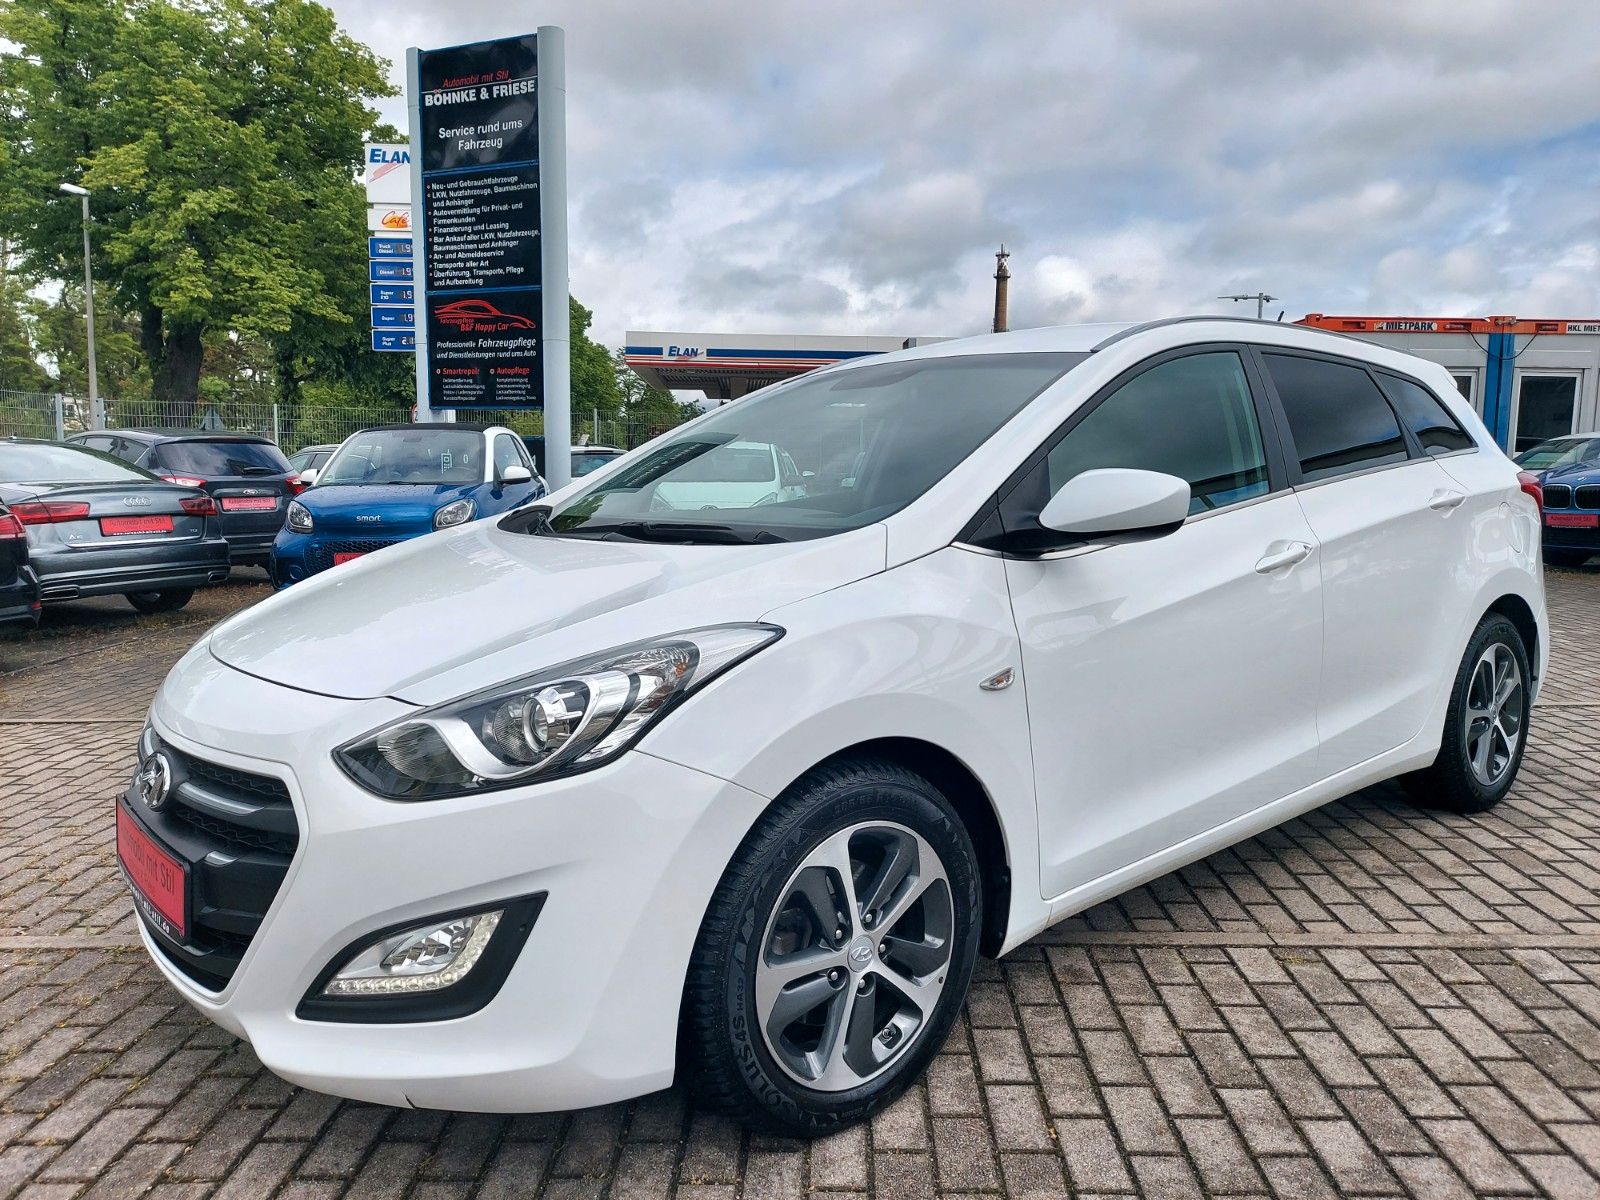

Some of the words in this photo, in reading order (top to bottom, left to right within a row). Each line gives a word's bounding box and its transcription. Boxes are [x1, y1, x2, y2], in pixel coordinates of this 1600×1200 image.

[443, 74, 479, 88] Automobil
[481, 73, 493, 83] mit
[496, 70, 510, 80] Stil
[425, 88, 476, 106] BÖHNKE
[480, 88, 489, 99] &
[493, 80, 535, 98] FRIESE
[438, 126, 474, 139] Service
[478, 122, 500, 134] rund
[503, 120, 522, 130] ums
[458, 137, 503, 150] Fahrzeug
[369, 148, 410, 163] ELAN
[460, 176, 518, 187] Gebrauchtfahrzeuge
[494, 182, 538, 193] Baumaschinen
[433, 207, 480, 216] Autovermittlung
[434, 216, 475, 225] Firmenkunden
[434, 225, 471, 234] Finanzierung
[491, 240, 518, 248] Anhänger
[457, 250, 504, 259] Abmeldeservice
[433, 262, 464, 270] Transporte
[446, 277, 483, 286] Aufbereitung
[475, 323, 496, 332] Happy
[1386, 322, 1433, 330] MIETPARK
[437, 340, 476, 348] Professionelle
[478, 337, 536, 349] Fahrzeugpflege
[449, 351, 495, 359] Dienstleistungen
[668, 346, 698, 356] ELAN
[496, 367, 530, 376] Autopflege
[160, 862, 175, 896] Stil
